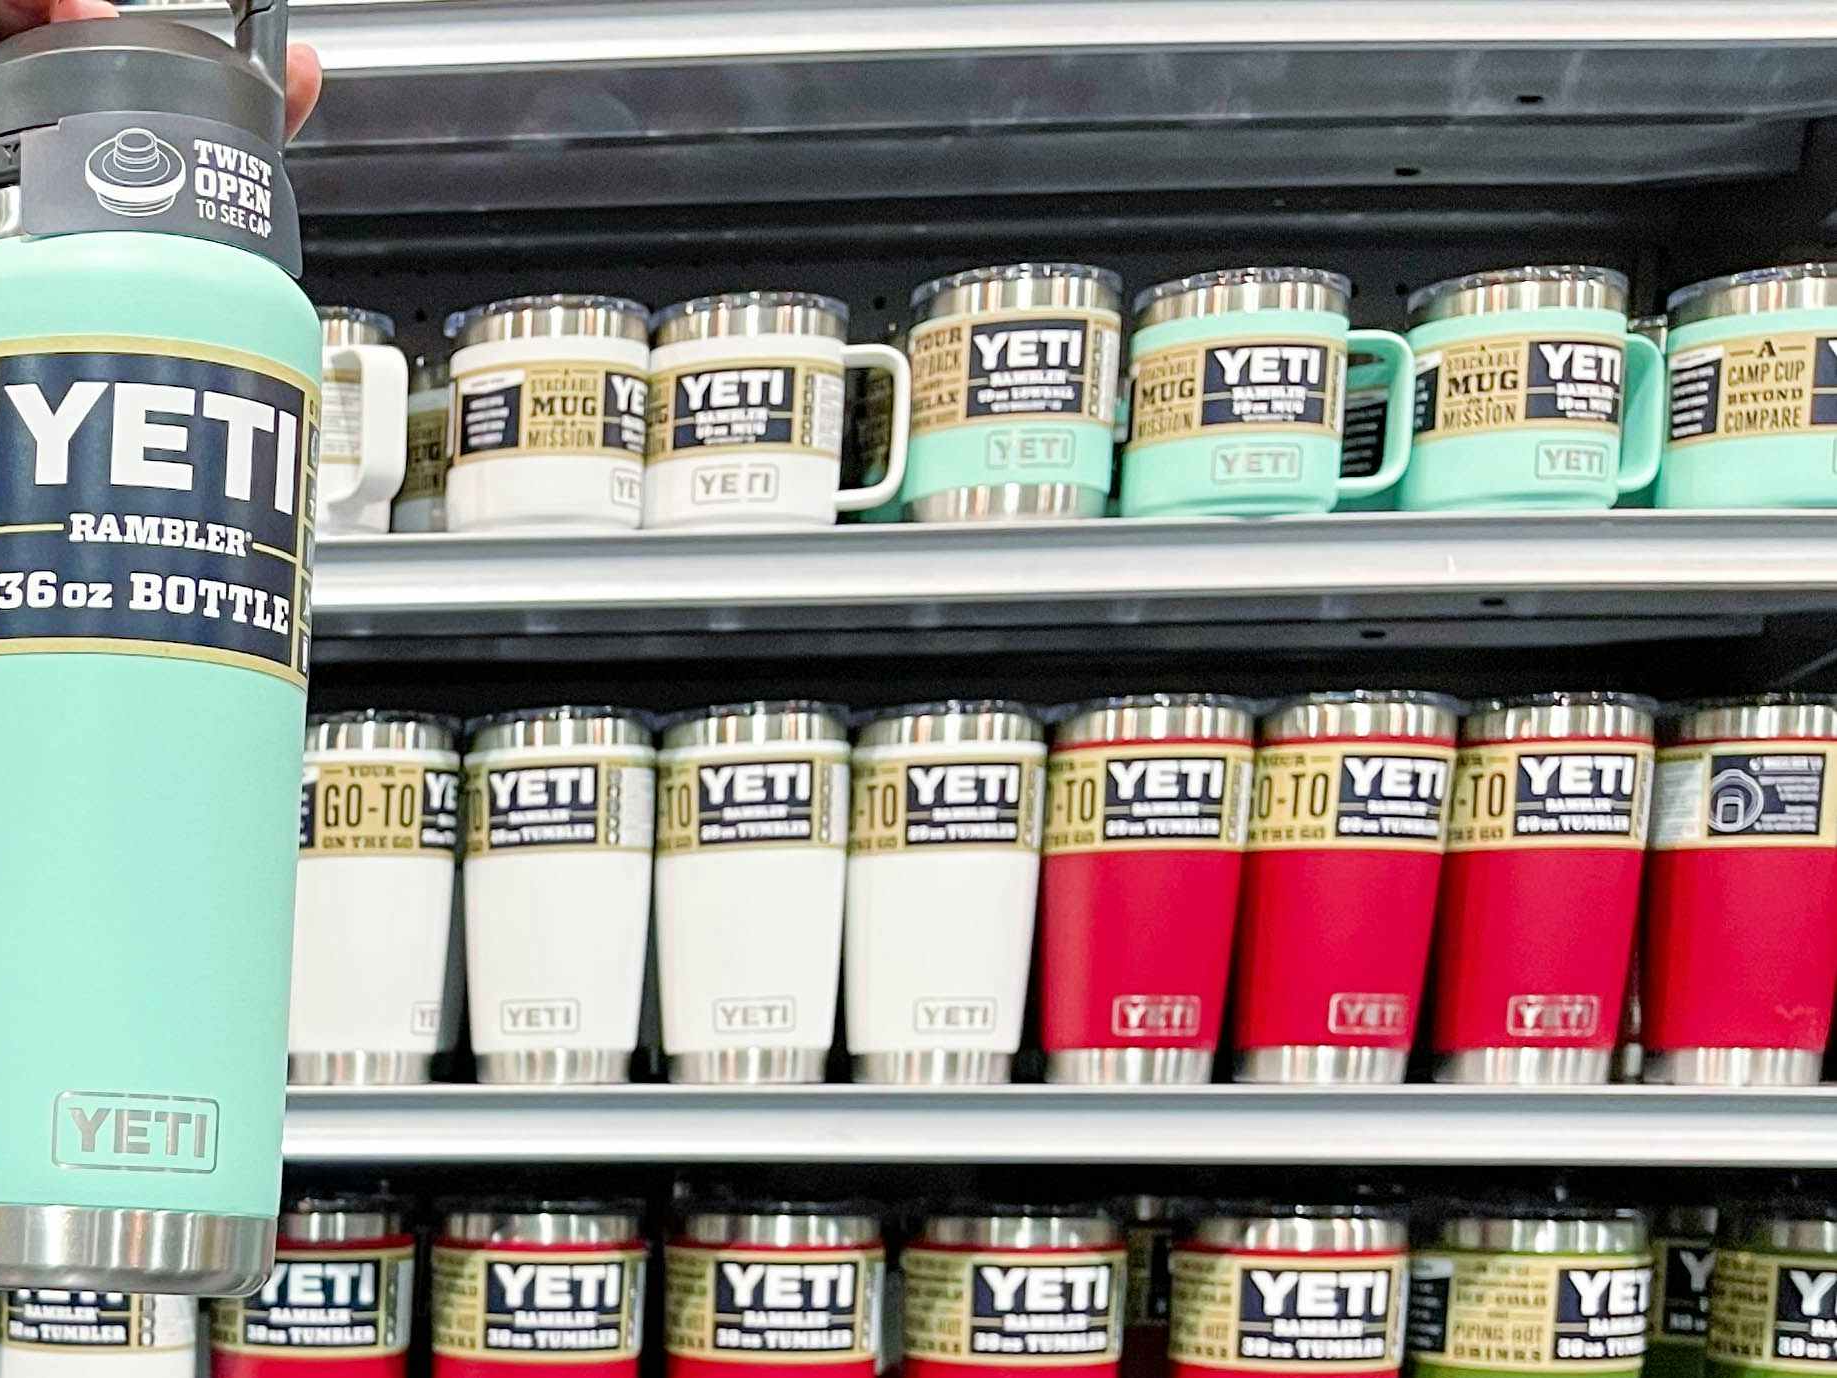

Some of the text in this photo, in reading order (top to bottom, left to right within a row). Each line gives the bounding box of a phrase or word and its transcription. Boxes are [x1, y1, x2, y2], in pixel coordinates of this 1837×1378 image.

[193, 139, 272, 187] TWIST
[193, 171, 272, 219] OPEN
[198, 199, 272, 239] TO SEE CAP
[972, 328, 1083, 371] YETI
[1214, 347, 1321, 386] YETI
[1538, 342, 1621, 385] YETI
[1756, 341, 1778, 358] A
[680, 371, 785, 410] YETI
[1141, 378, 1195, 409] MUG
[1447, 370, 1519, 399] MUG
[1727, 362, 1771, 389] CAMP
[1773, 360, 1806, 384] CUP
[530, 397, 597, 417] MUG
[611, 374, 649, 417] YE
[1727, 387, 1805, 405] BEYOND
[1443, 402, 1516, 430] MISSION
[1724, 406, 1803, 433] COMPARE
[3, 381, 298, 516] YETI
[993, 435, 1071, 461] YETI
[1218, 454, 1297, 477] YETI
[1543, 447, 1606, 475] YETI
[699, 473, 774, 497] YETI
[68, 512, 247, 557] RAMBLER
[128, 572, 291, 636] BOTTLE
[424, 772, 459, 810] YE
[489, 767, 596, 809] YETI
[700, 762, 812, 805] YETI
[907, 764, 1021, 806] YETI
[1107, 759, 1225, 800] YETI
[1344, 757, 1444, 800] YETI
[1520, 756, 1636, 796] YETI
[323, 783, 416, 829] GO-TO
[1258, 773, 1329, 821] O-TO
[507, 1007, 571, 1028] YETI
[719, 1005, 789, 1027] YETI
[922, 1005, 990, 1027] YETI
[67, 1106, 208, 1159] YETI
[262, 1263, 375, 1305] YETI
[493, 1264, 620, 1309] YETI
[722, 1264, 856, 1310] YETI
[980, 1265, 1110, 1312] YETI
[1250, 1270, 1388, 1318] YETI
[1568, 1269, 1652, 1318] YET
[38, 1322, 127, 1343] TUMBLER
[288, 1325, 377, 1346] TUMBLER
